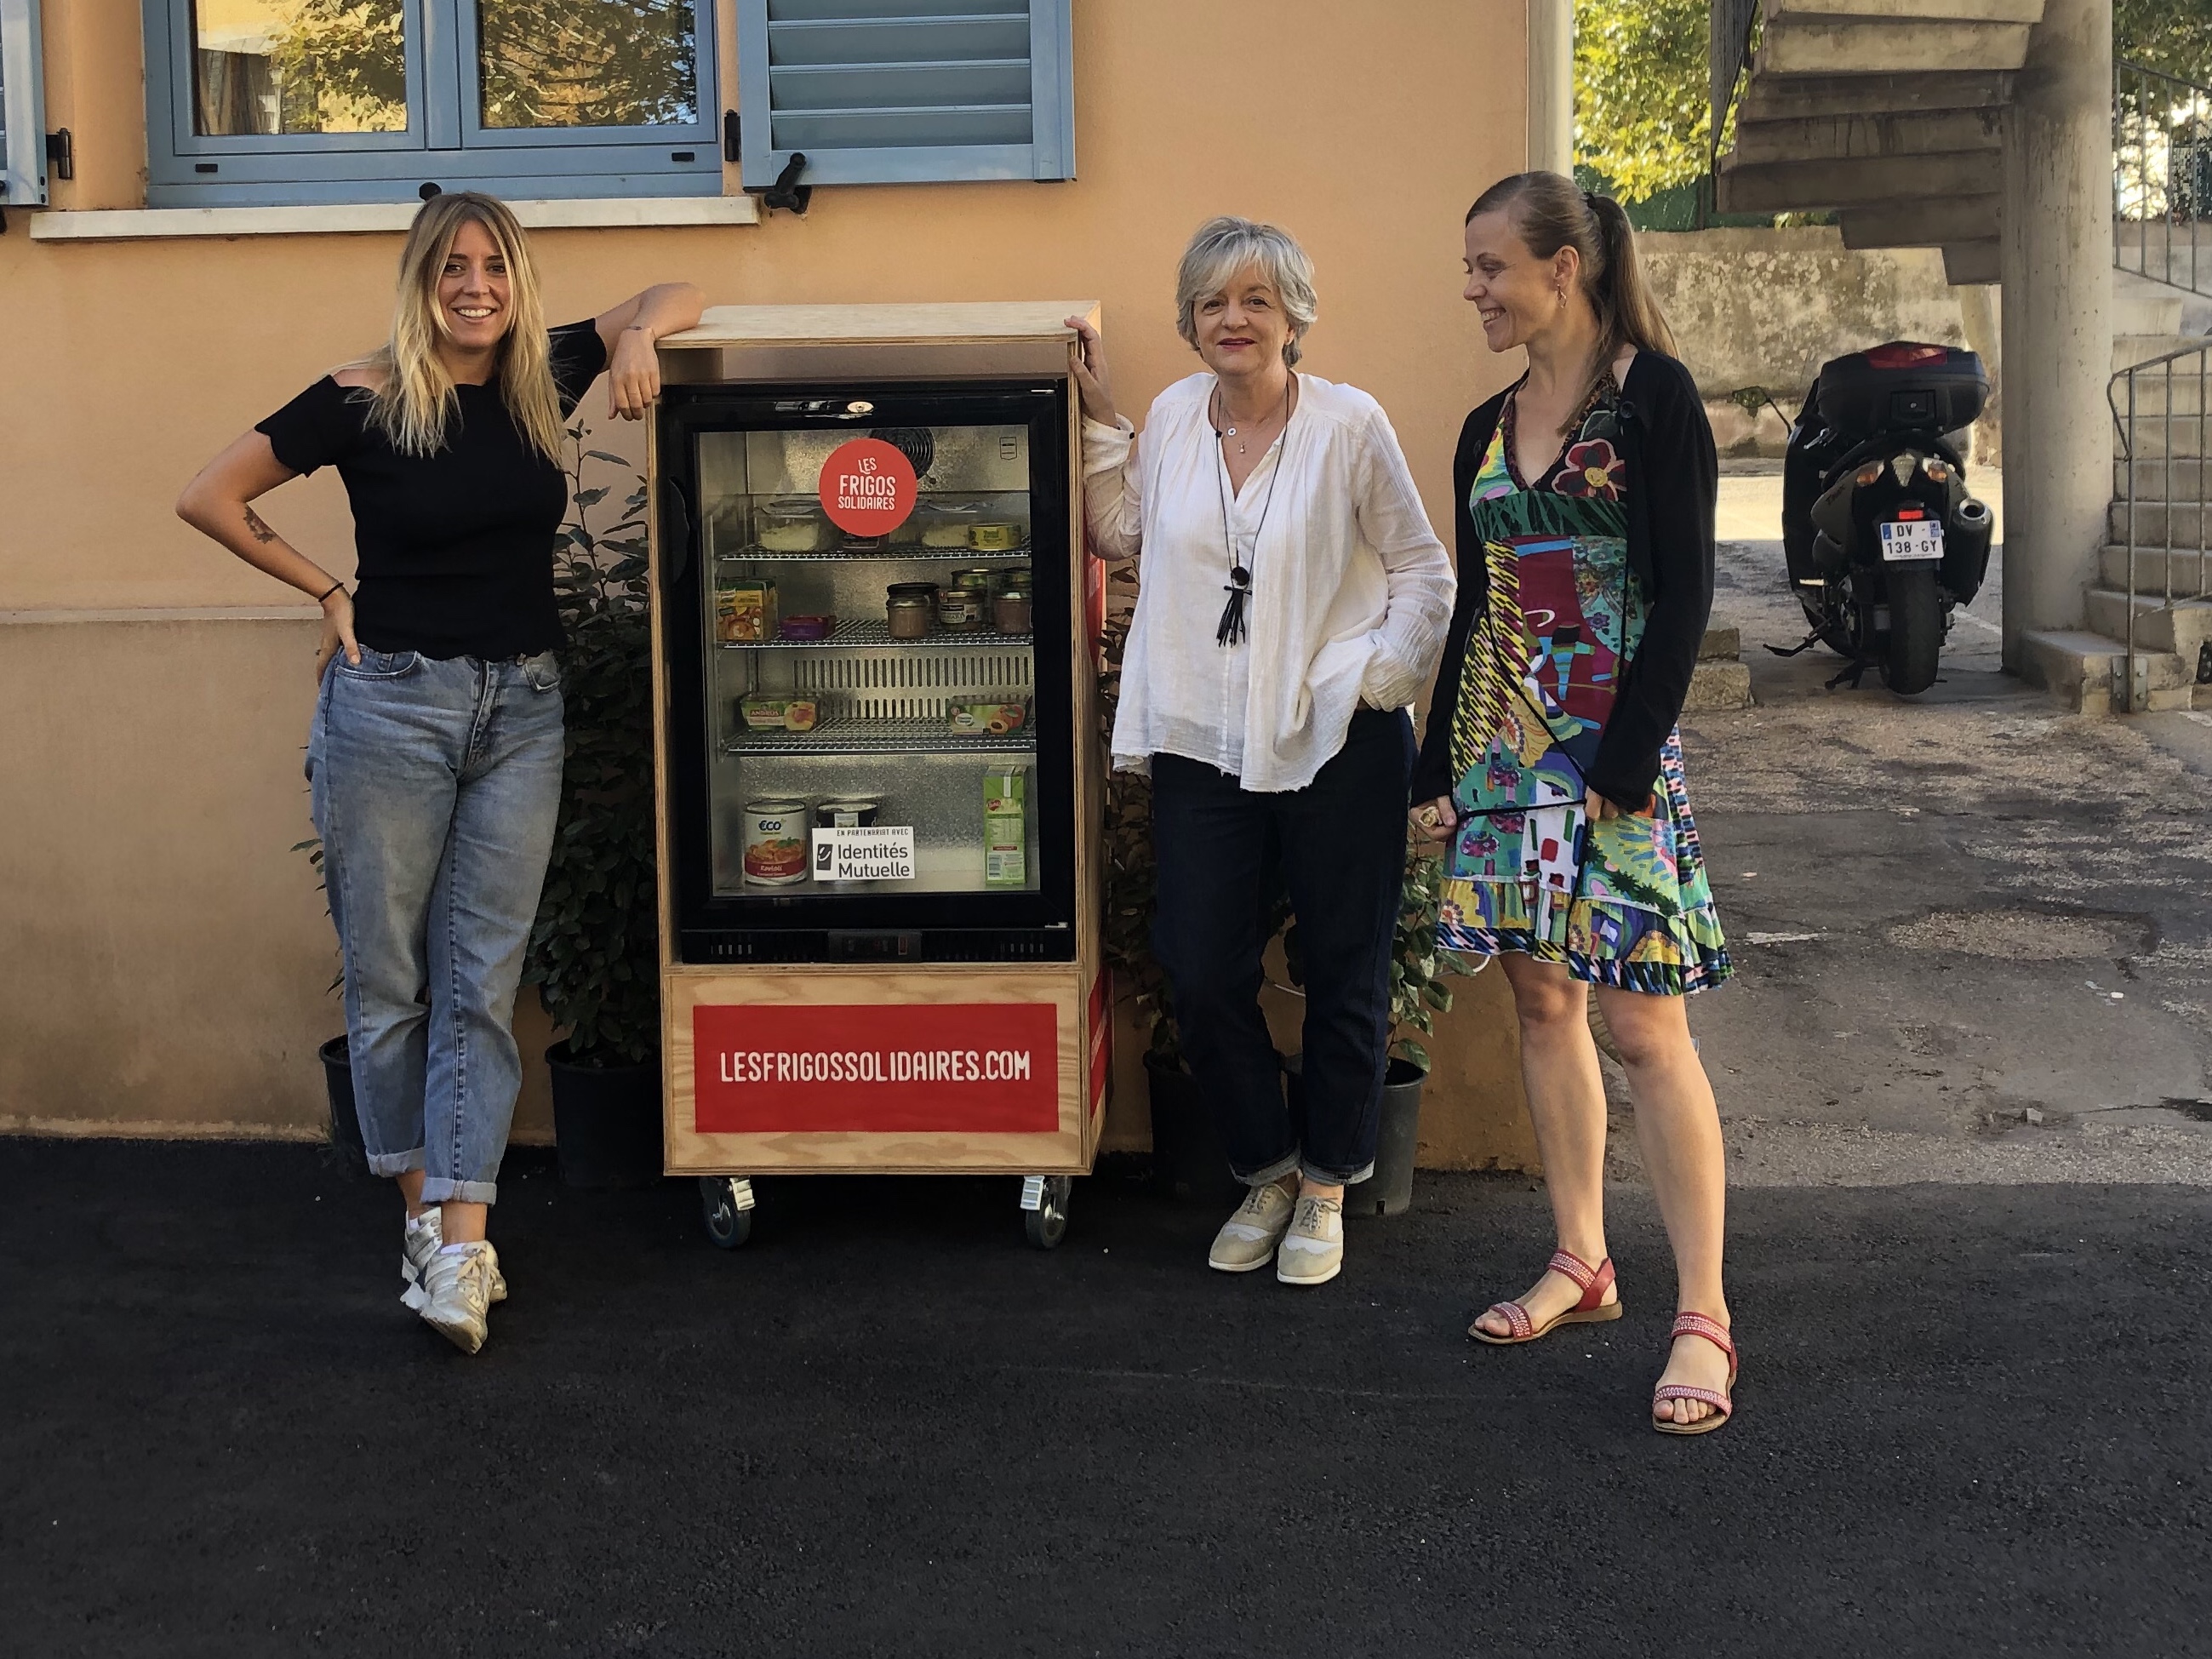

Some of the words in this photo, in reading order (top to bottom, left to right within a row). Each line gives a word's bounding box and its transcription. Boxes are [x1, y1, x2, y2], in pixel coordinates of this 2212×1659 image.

[858, 457, 877, 474] LES
[839, 474, 896, 496] FRIGOS
[837, 495, 895, 511] SOLIDAIRES
[1896, 524, 1912, 537] DV
[847, 828, 889, 837] PARTENARIAT
[837, 842, 908, 860] Identités
[838, 861, 910, 878] Mutuelle
[720, 1050, 1031, 1083] LESFRIGOSSOLIDAIRES.COM
